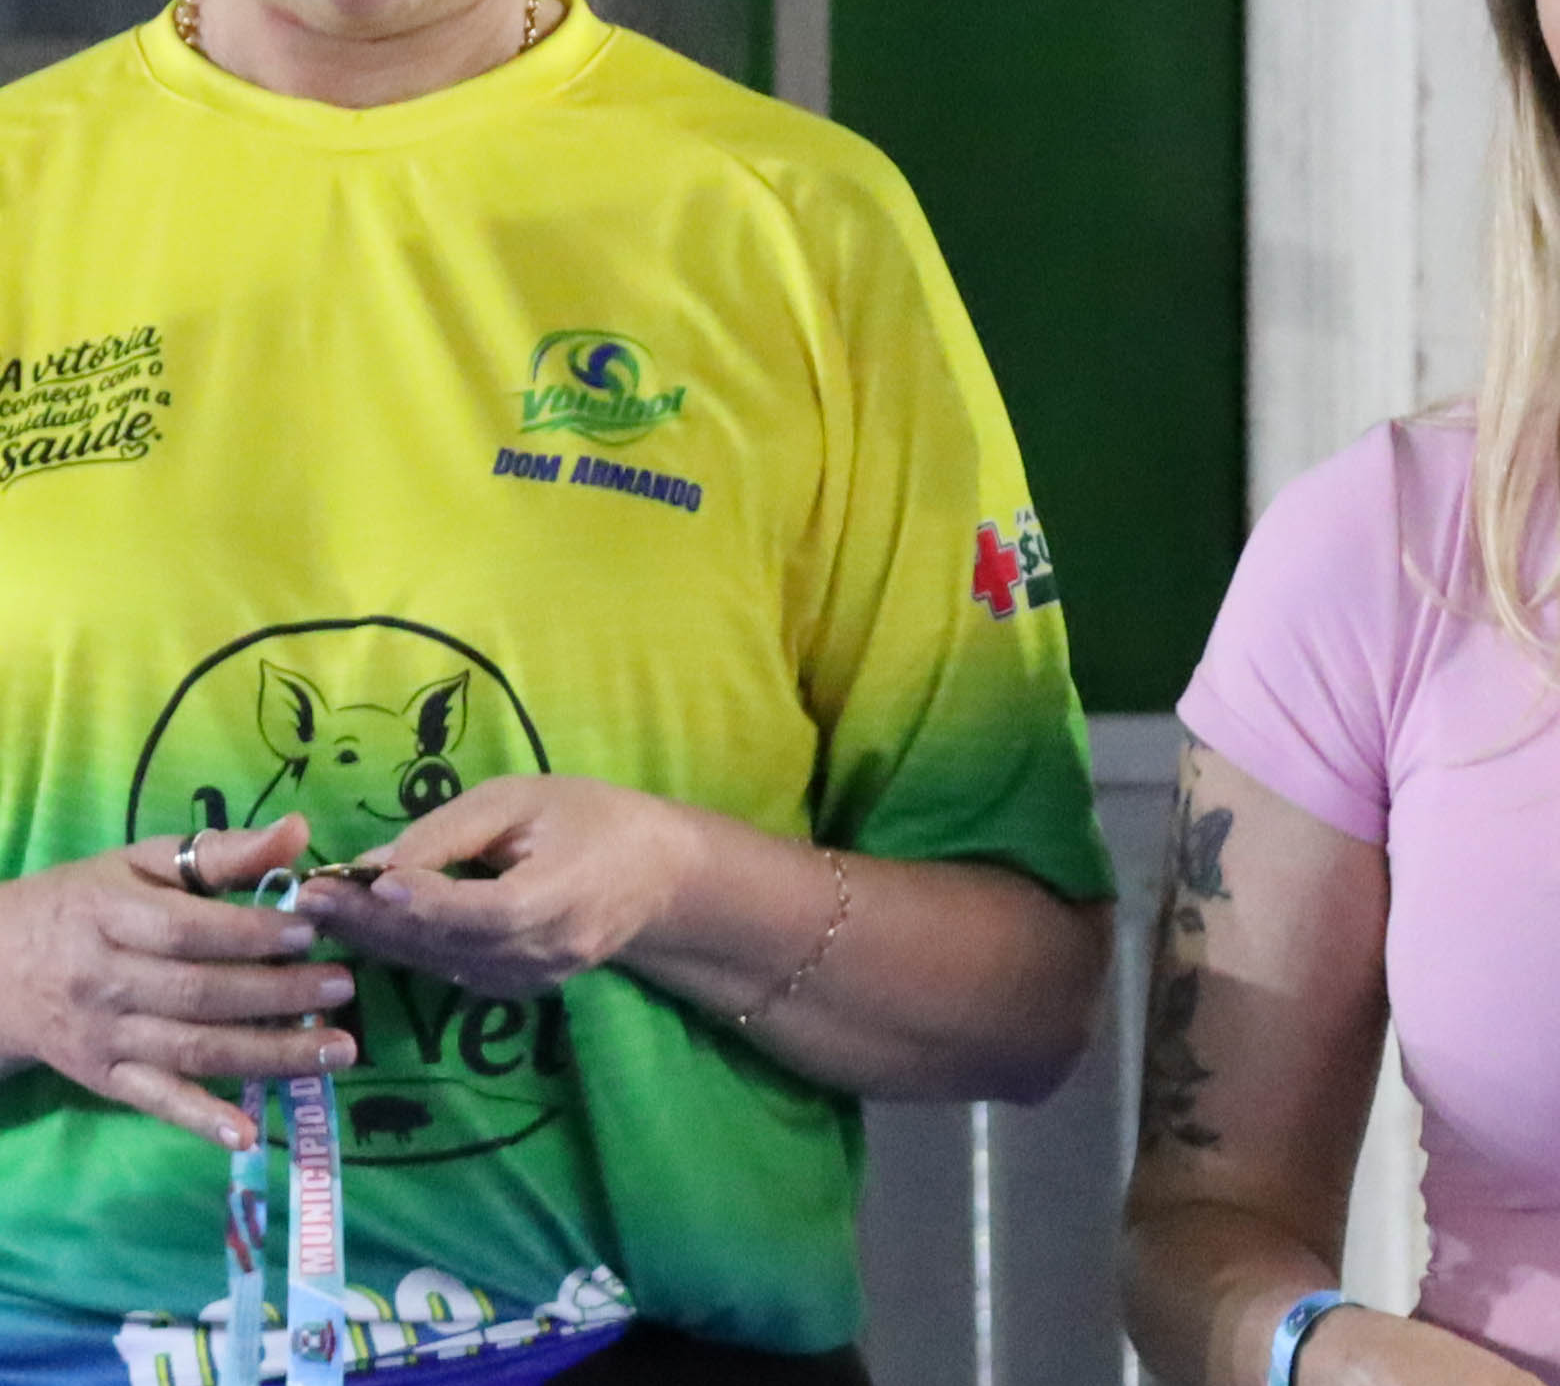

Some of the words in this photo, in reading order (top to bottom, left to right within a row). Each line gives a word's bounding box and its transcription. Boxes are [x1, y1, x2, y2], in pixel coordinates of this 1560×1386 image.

[98, 364, 142, 393] com
[106, 386, 150, 414] com
[492, 447, 563, 483] DOM
[570, 455, 703, 513] ARMANDO
